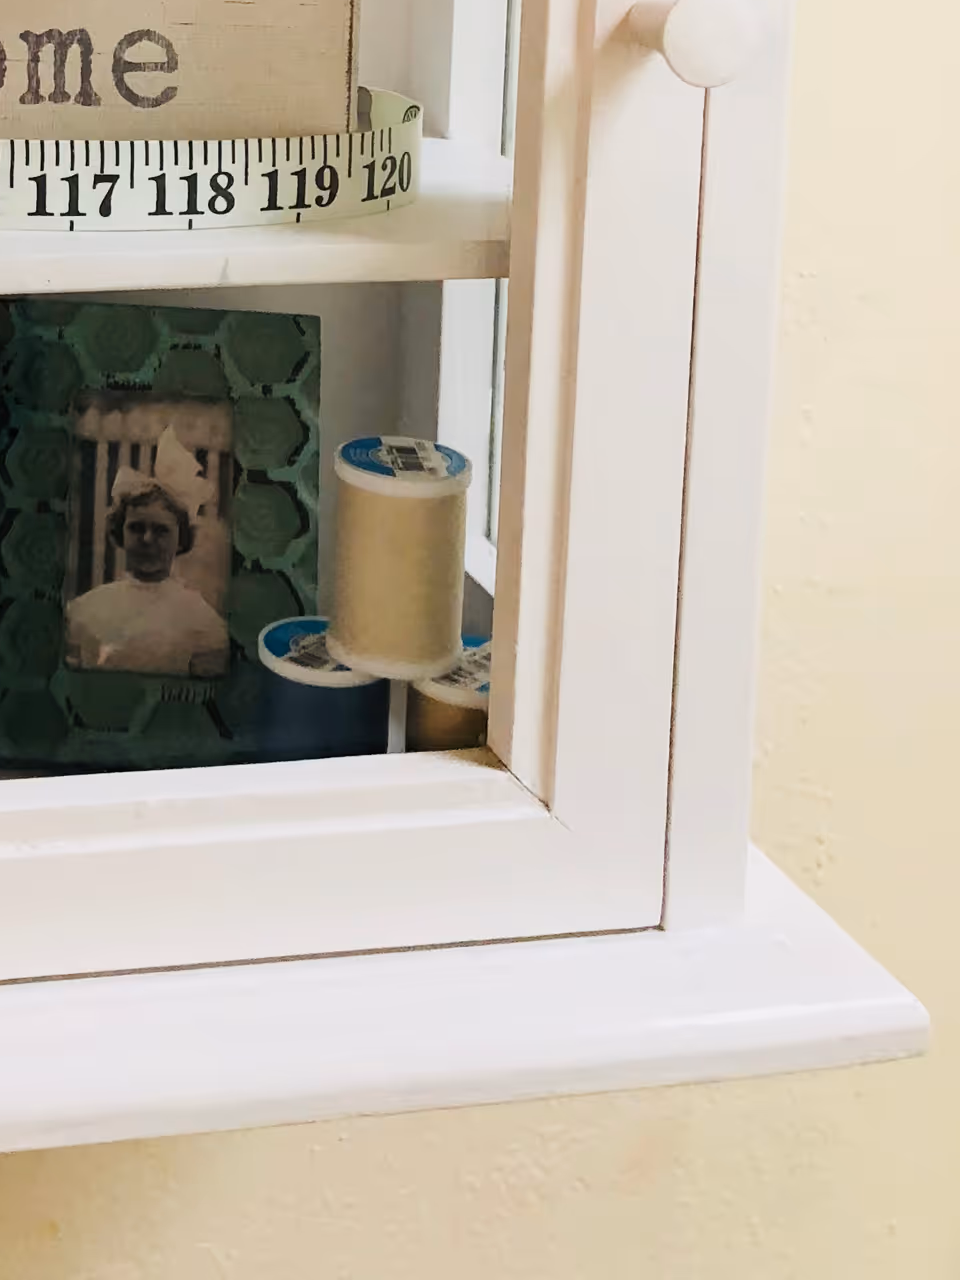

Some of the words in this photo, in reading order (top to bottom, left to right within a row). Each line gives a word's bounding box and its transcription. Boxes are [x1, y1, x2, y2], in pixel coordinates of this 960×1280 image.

[27, 173, 120, 217] 117
[147, 171, 235, 216] 118
[260, 165, 339, 211] 119
[361, 151, 412, 203] 120
